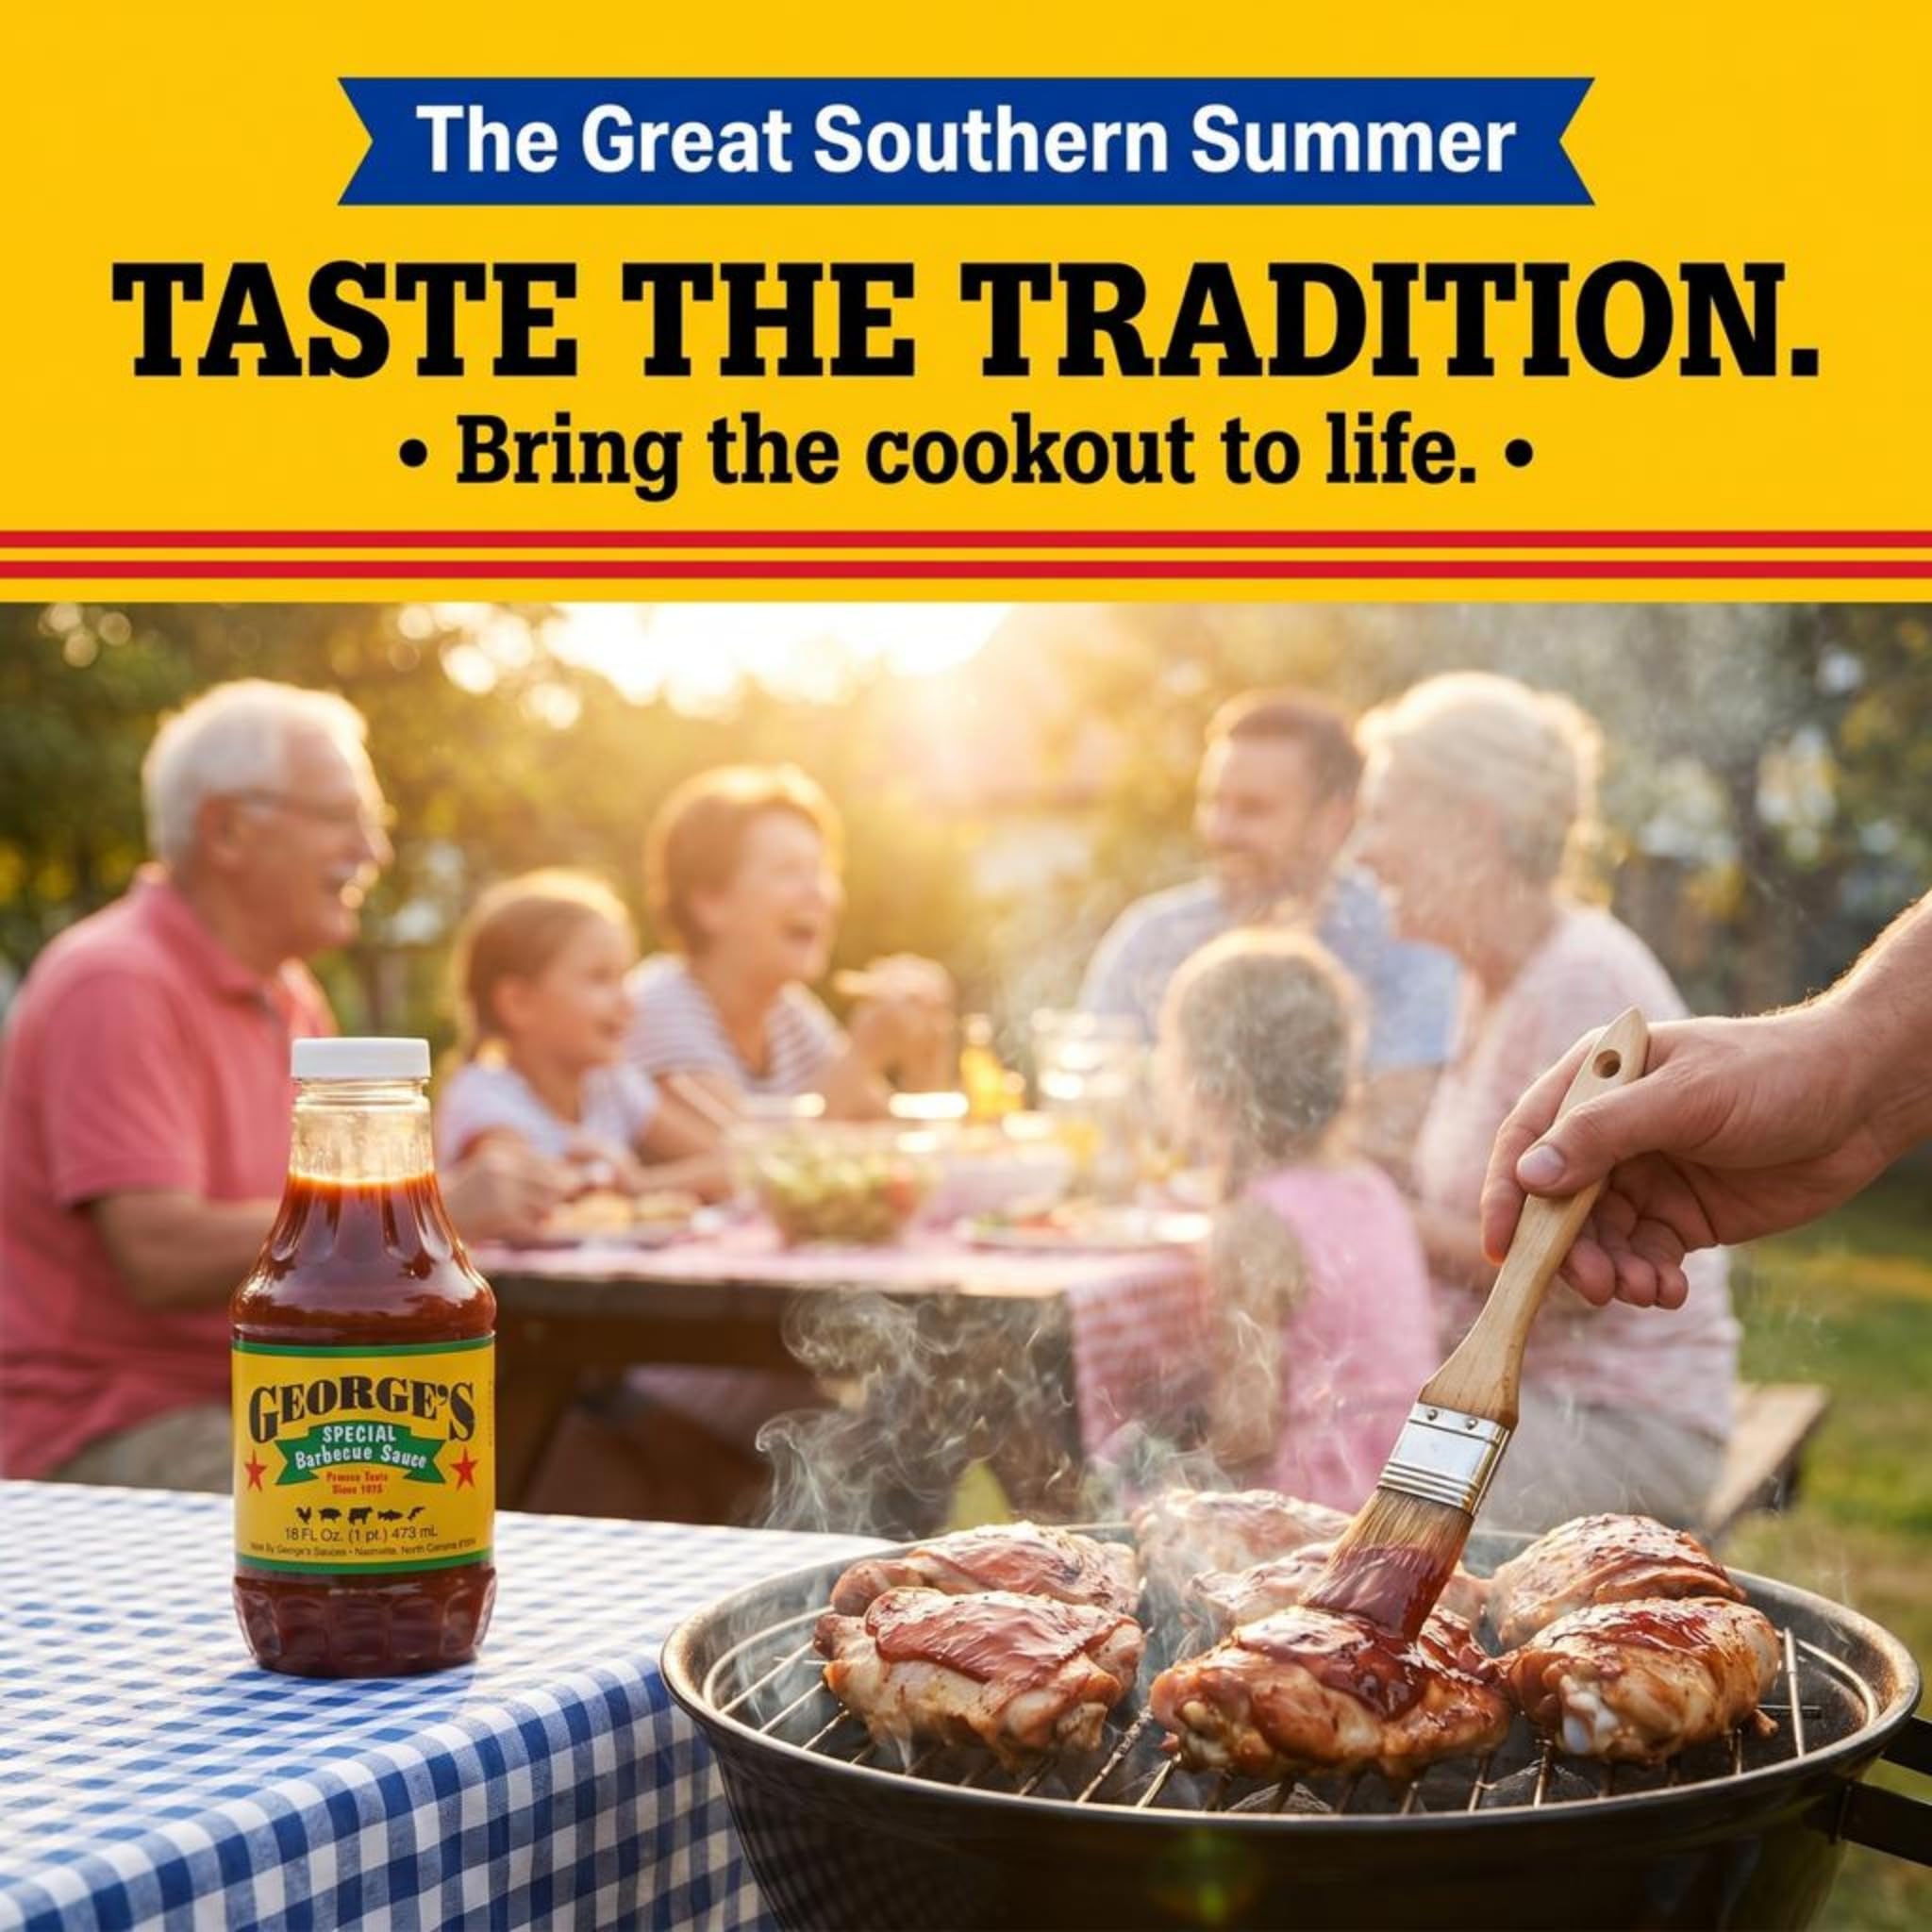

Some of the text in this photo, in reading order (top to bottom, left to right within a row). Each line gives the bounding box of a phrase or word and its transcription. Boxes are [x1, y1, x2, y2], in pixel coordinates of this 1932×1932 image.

[248, 1375, 475, 1444] GEORGE'S
[322, 1425, 397, 1444] SPECIAL
[294, 1445, 427, 1471] Barbecue Sauce
[286, 1527, 299, 1541] 18
[348, 1528, 360, 1544] (1
[391, 1525, 416, 1540] 473
[420, 1524, 439, 1539] mL
